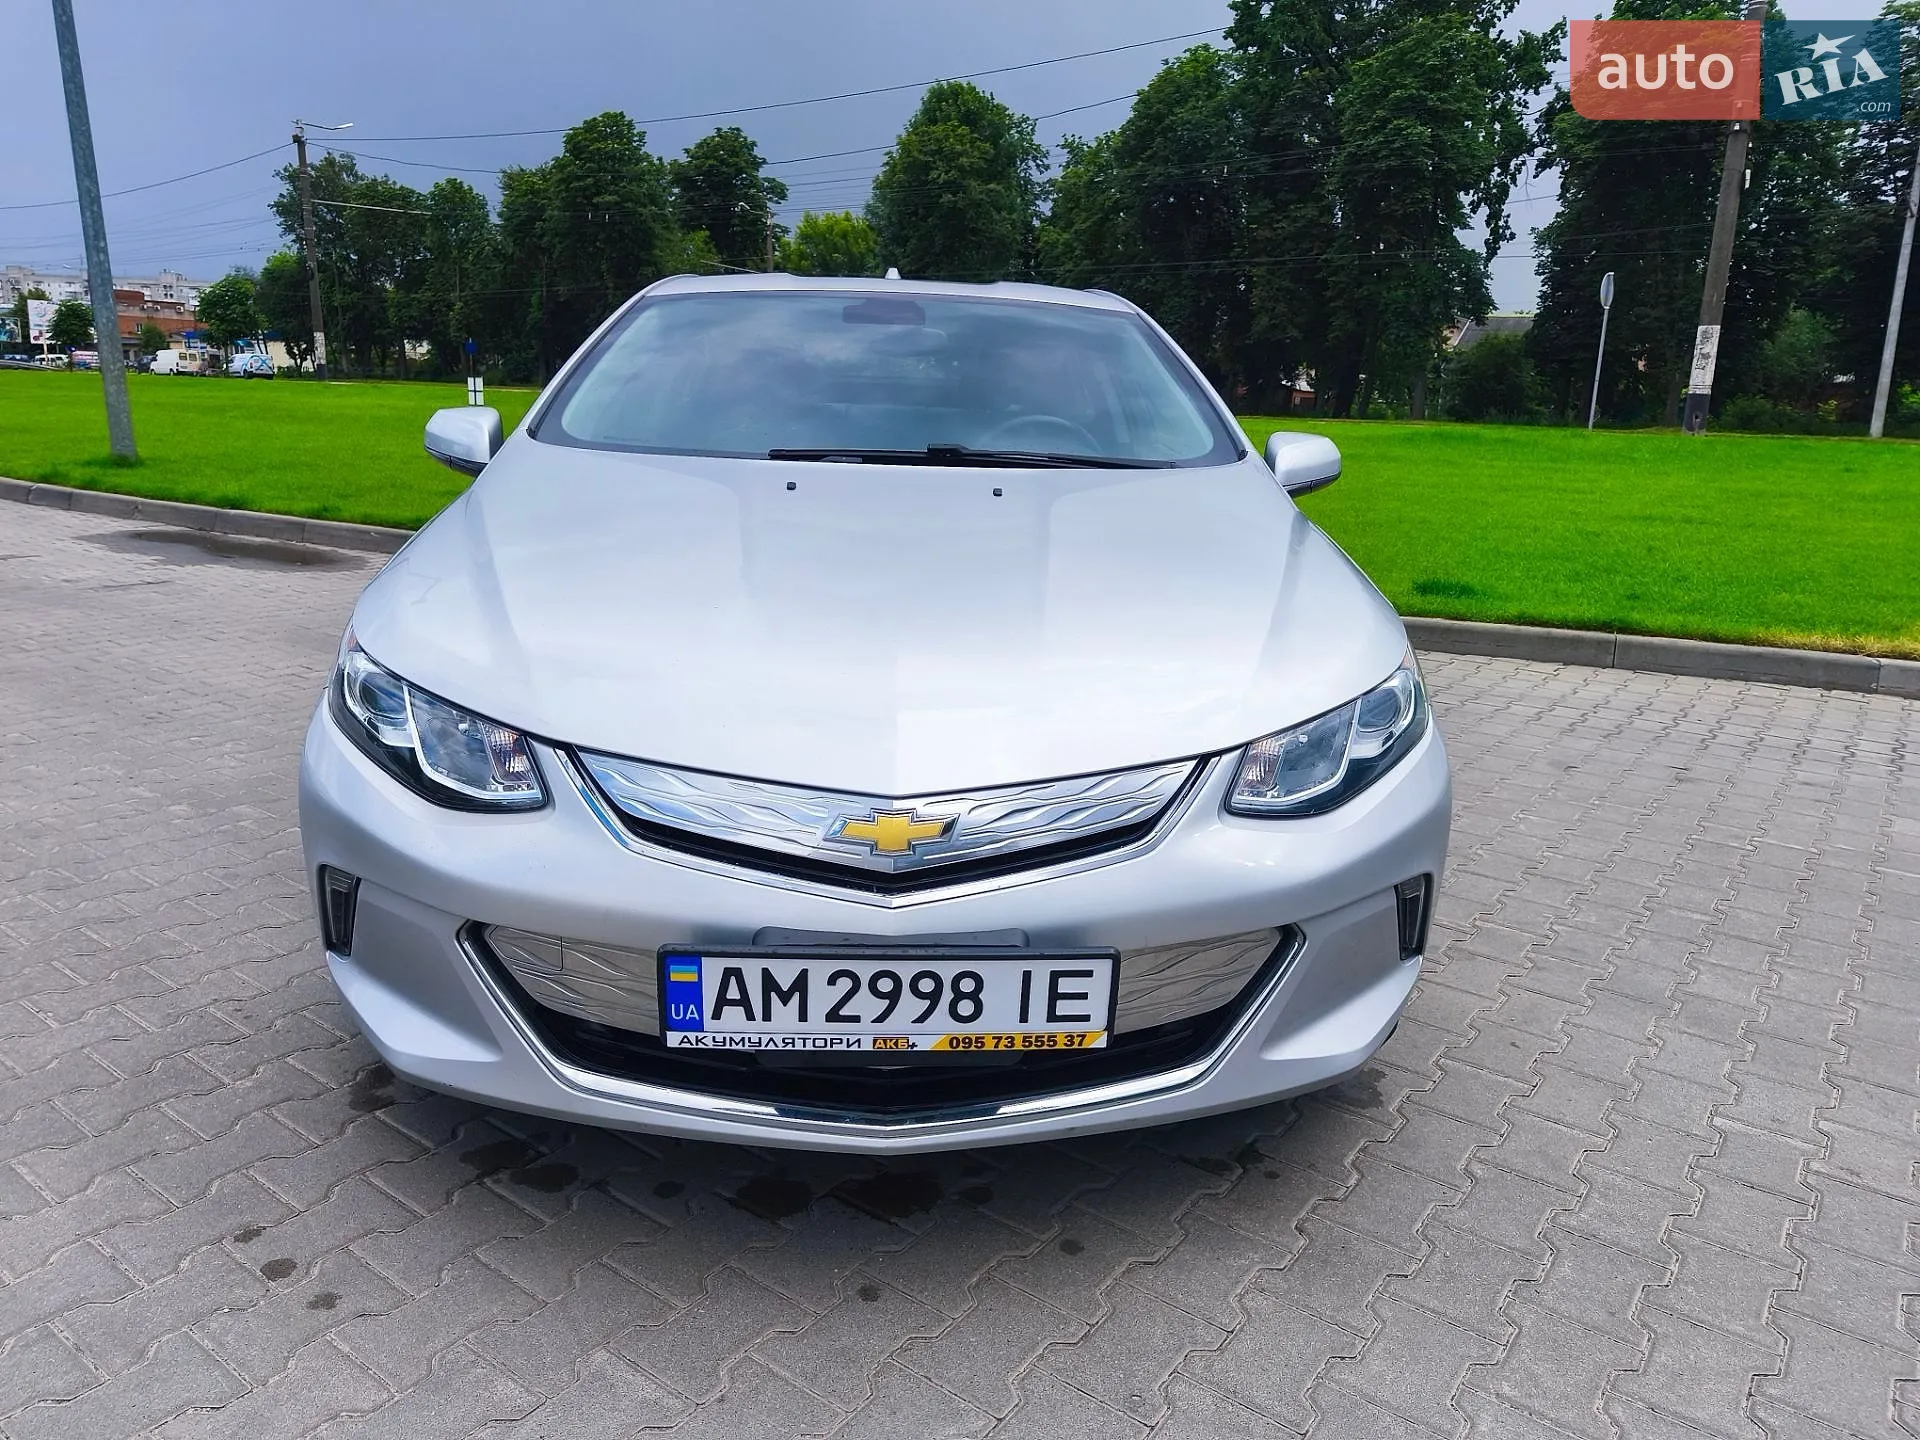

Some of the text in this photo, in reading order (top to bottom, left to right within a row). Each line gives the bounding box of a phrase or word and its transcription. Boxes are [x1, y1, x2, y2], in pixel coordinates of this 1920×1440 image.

[711, 966, 1094, 1024] AM 2998 IE
[671, 1003, 699, 1020] UA
[678, 1035, 862, 1049] АКУМУЛЯТОРИ
[948, 1036, 985, 1049] 095
[992, 1035, 1016, 1049] 73
[1021, 1035, 1058, 1048] 555
[1063, 1034, 1088, 1047] 37
